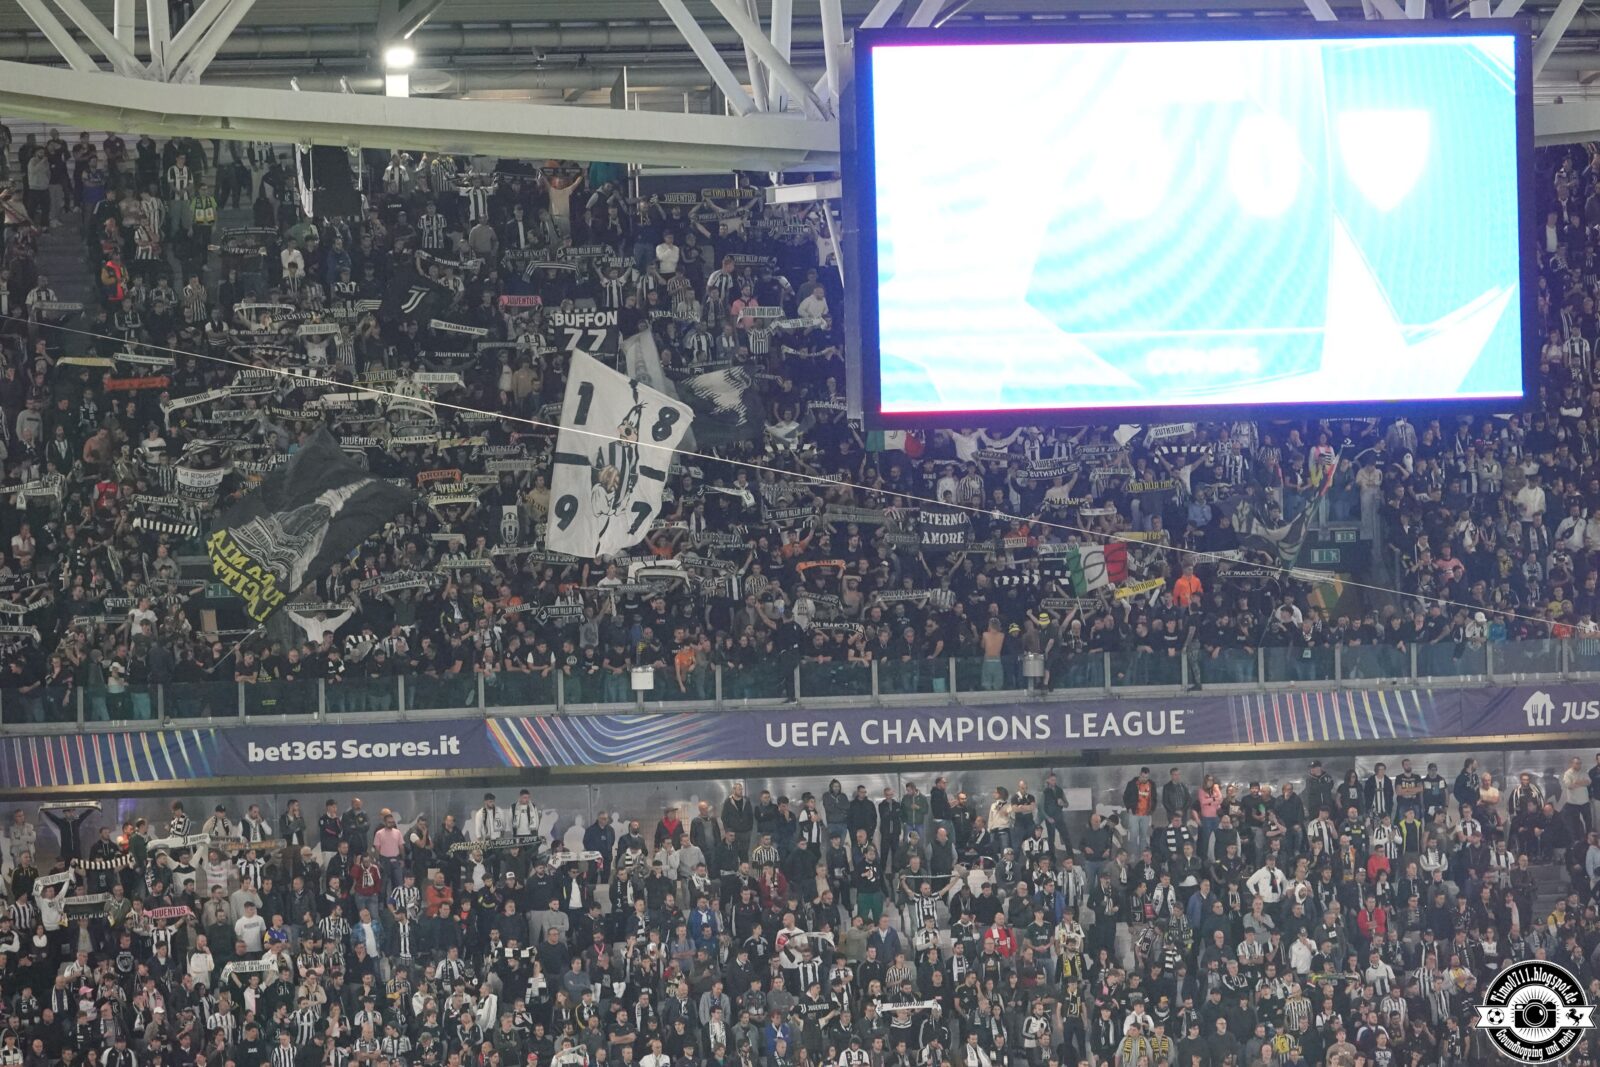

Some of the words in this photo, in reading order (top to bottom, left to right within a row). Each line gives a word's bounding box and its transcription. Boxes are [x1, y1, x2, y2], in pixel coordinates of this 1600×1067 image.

[507, 296, 538, 305] JUVENTUS
[554, 311, 618, 327] BUFFON
[564, 328, 607, 352] 77
[574, 381, 594, 426] 1
[652, 406, 680, 442] 8
[340, 436, 378, 446] JUVENTUS
[554, 494, 579, 531] 9
[628, 501, 653, 535] 7
[920, 511, 966, 526] ETERNO
[921, 531, 965, 546] AMORE
[1560, 700, 1600, 724] JUS
[765, 720, 852, 747] UEFA
[860, 713, 1051, 745] CHAMPIONS
[248, 739, 337, 763] bet365
[341, 734, 461, 760] Scores.it
[151, 907, 186, 918] JUVENTUS
